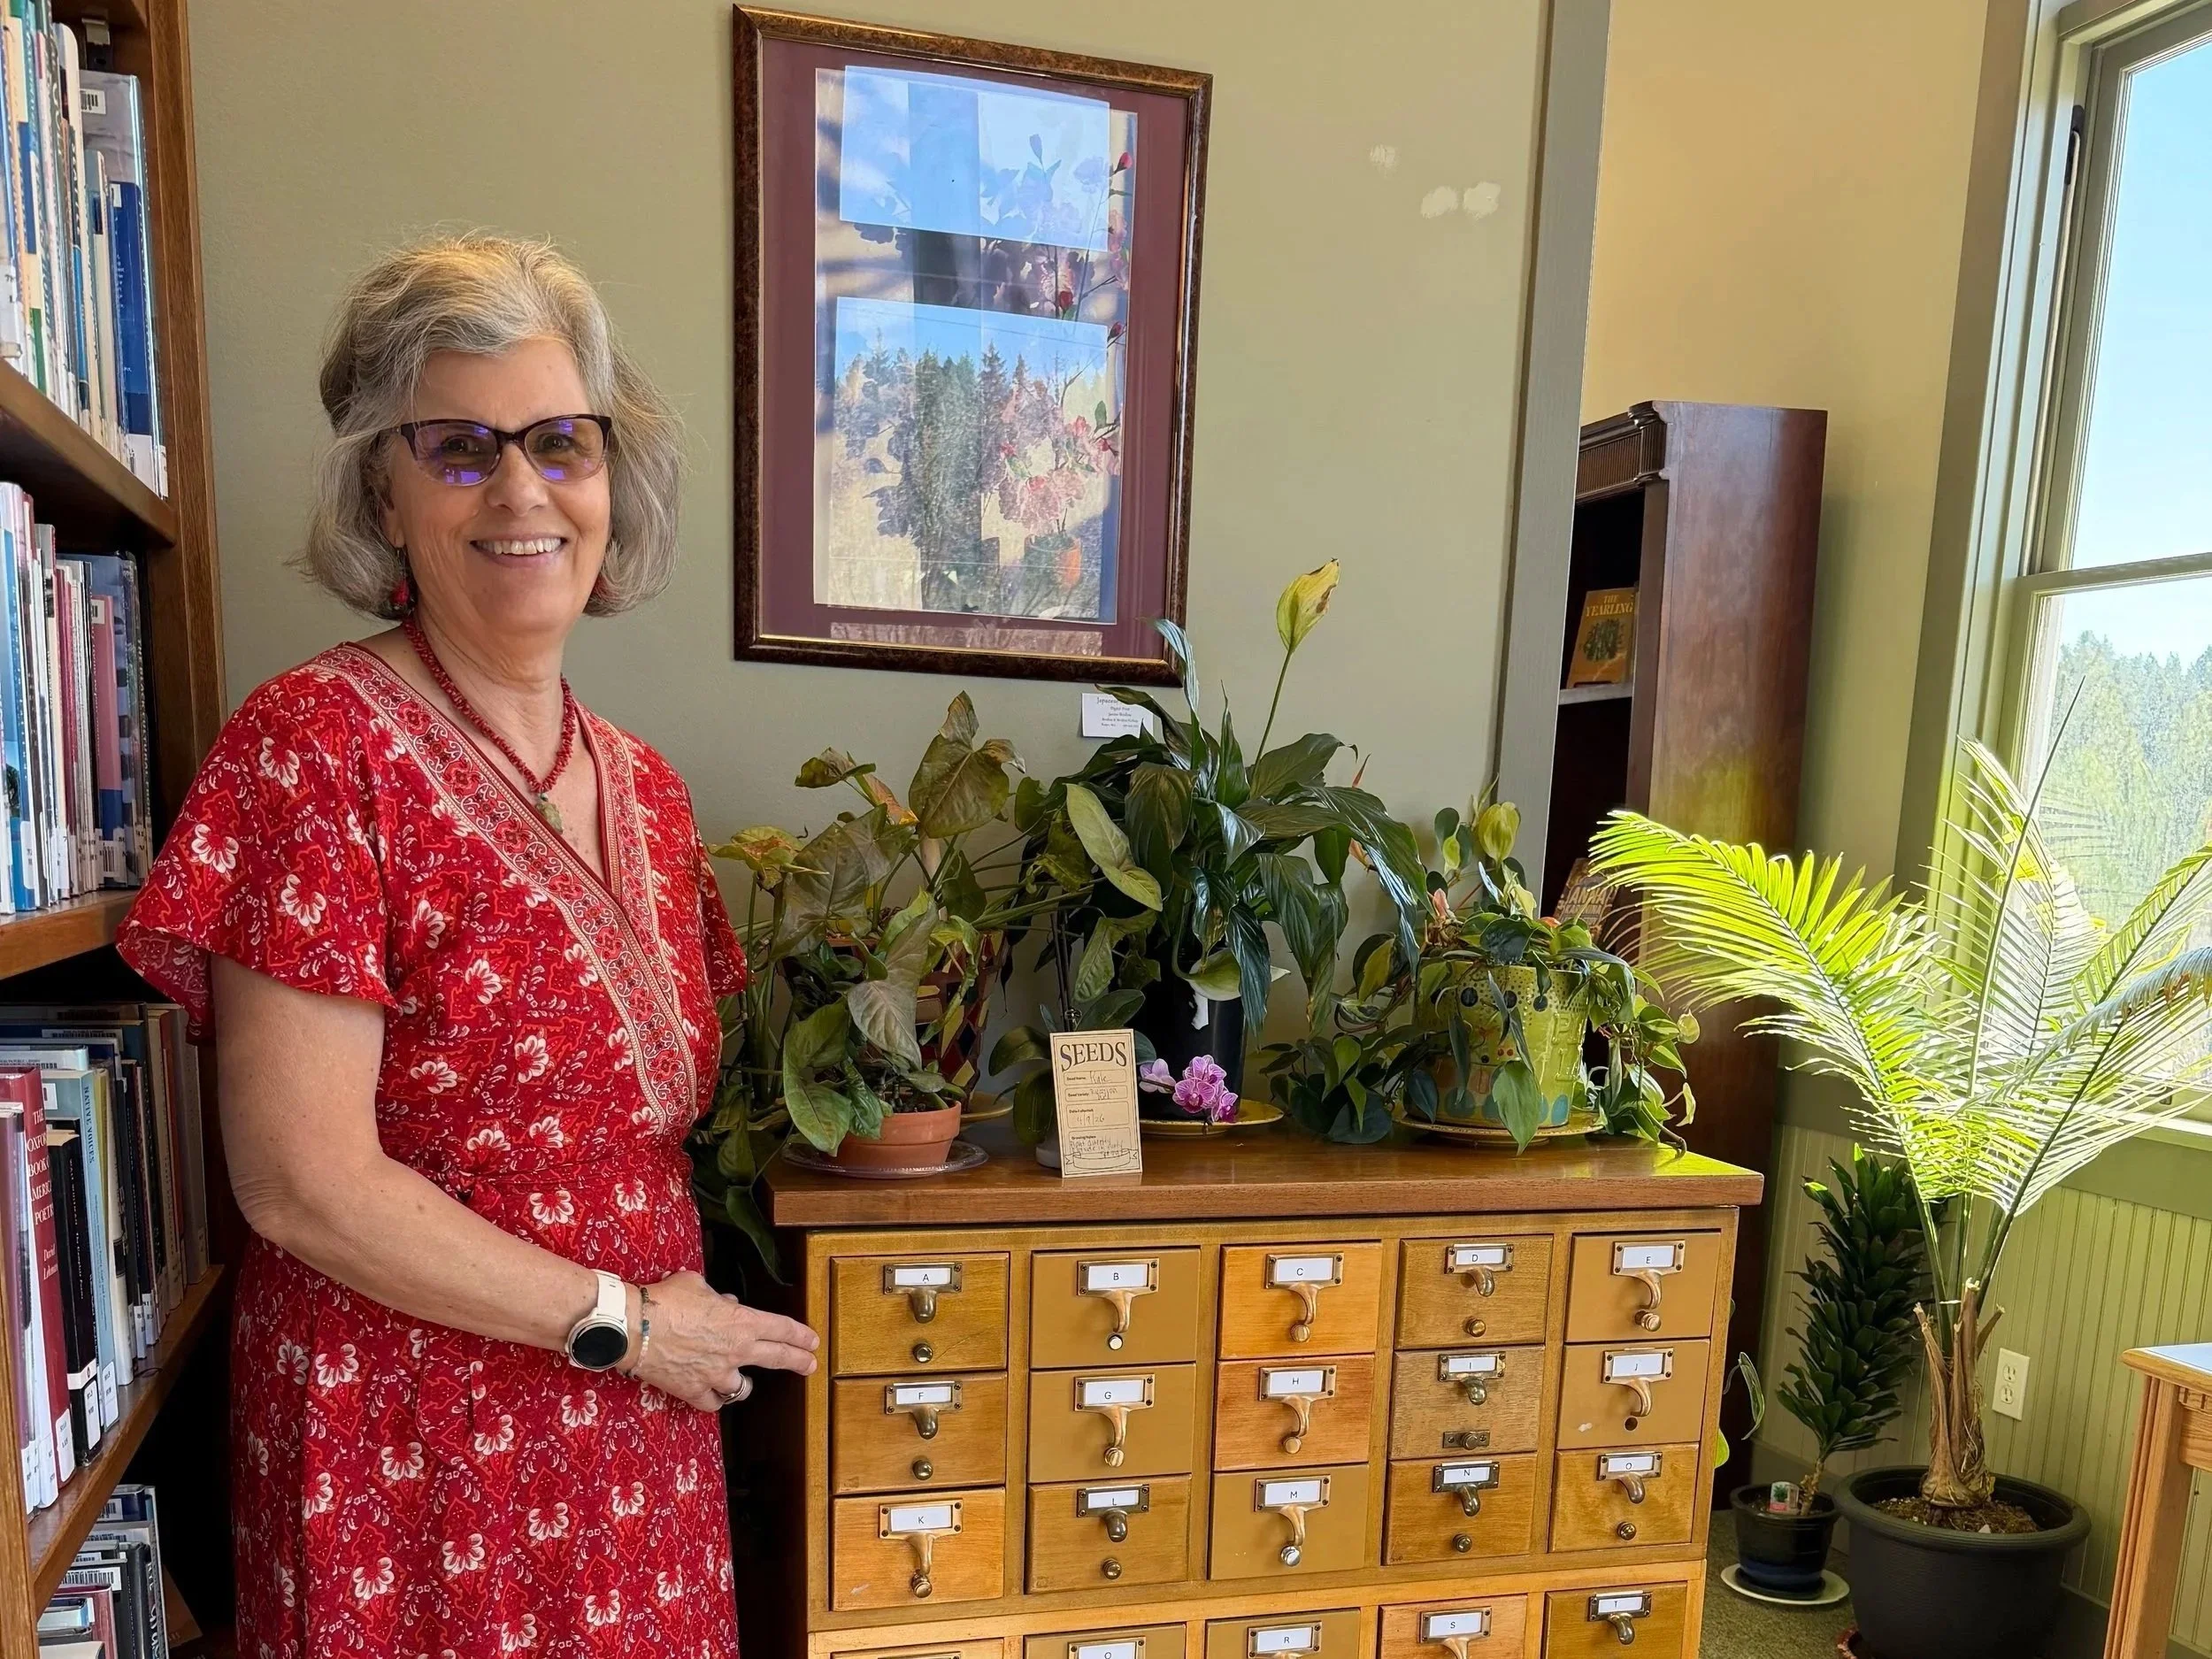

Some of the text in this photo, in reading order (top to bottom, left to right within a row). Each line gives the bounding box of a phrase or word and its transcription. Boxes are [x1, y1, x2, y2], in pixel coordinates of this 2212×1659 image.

[1603, 594, 1619, 603] THE
[1586, 602, 1634, 617] YEARLING
[1060, 1041, 1127, 1072] SEEDS
[84, 1087, 93, 1126] NATIVE
[33, 1108, 44, 1125] THE
[28, 1158, 47, 1177] BOOK
[43, 1242, 56, 1261] David
